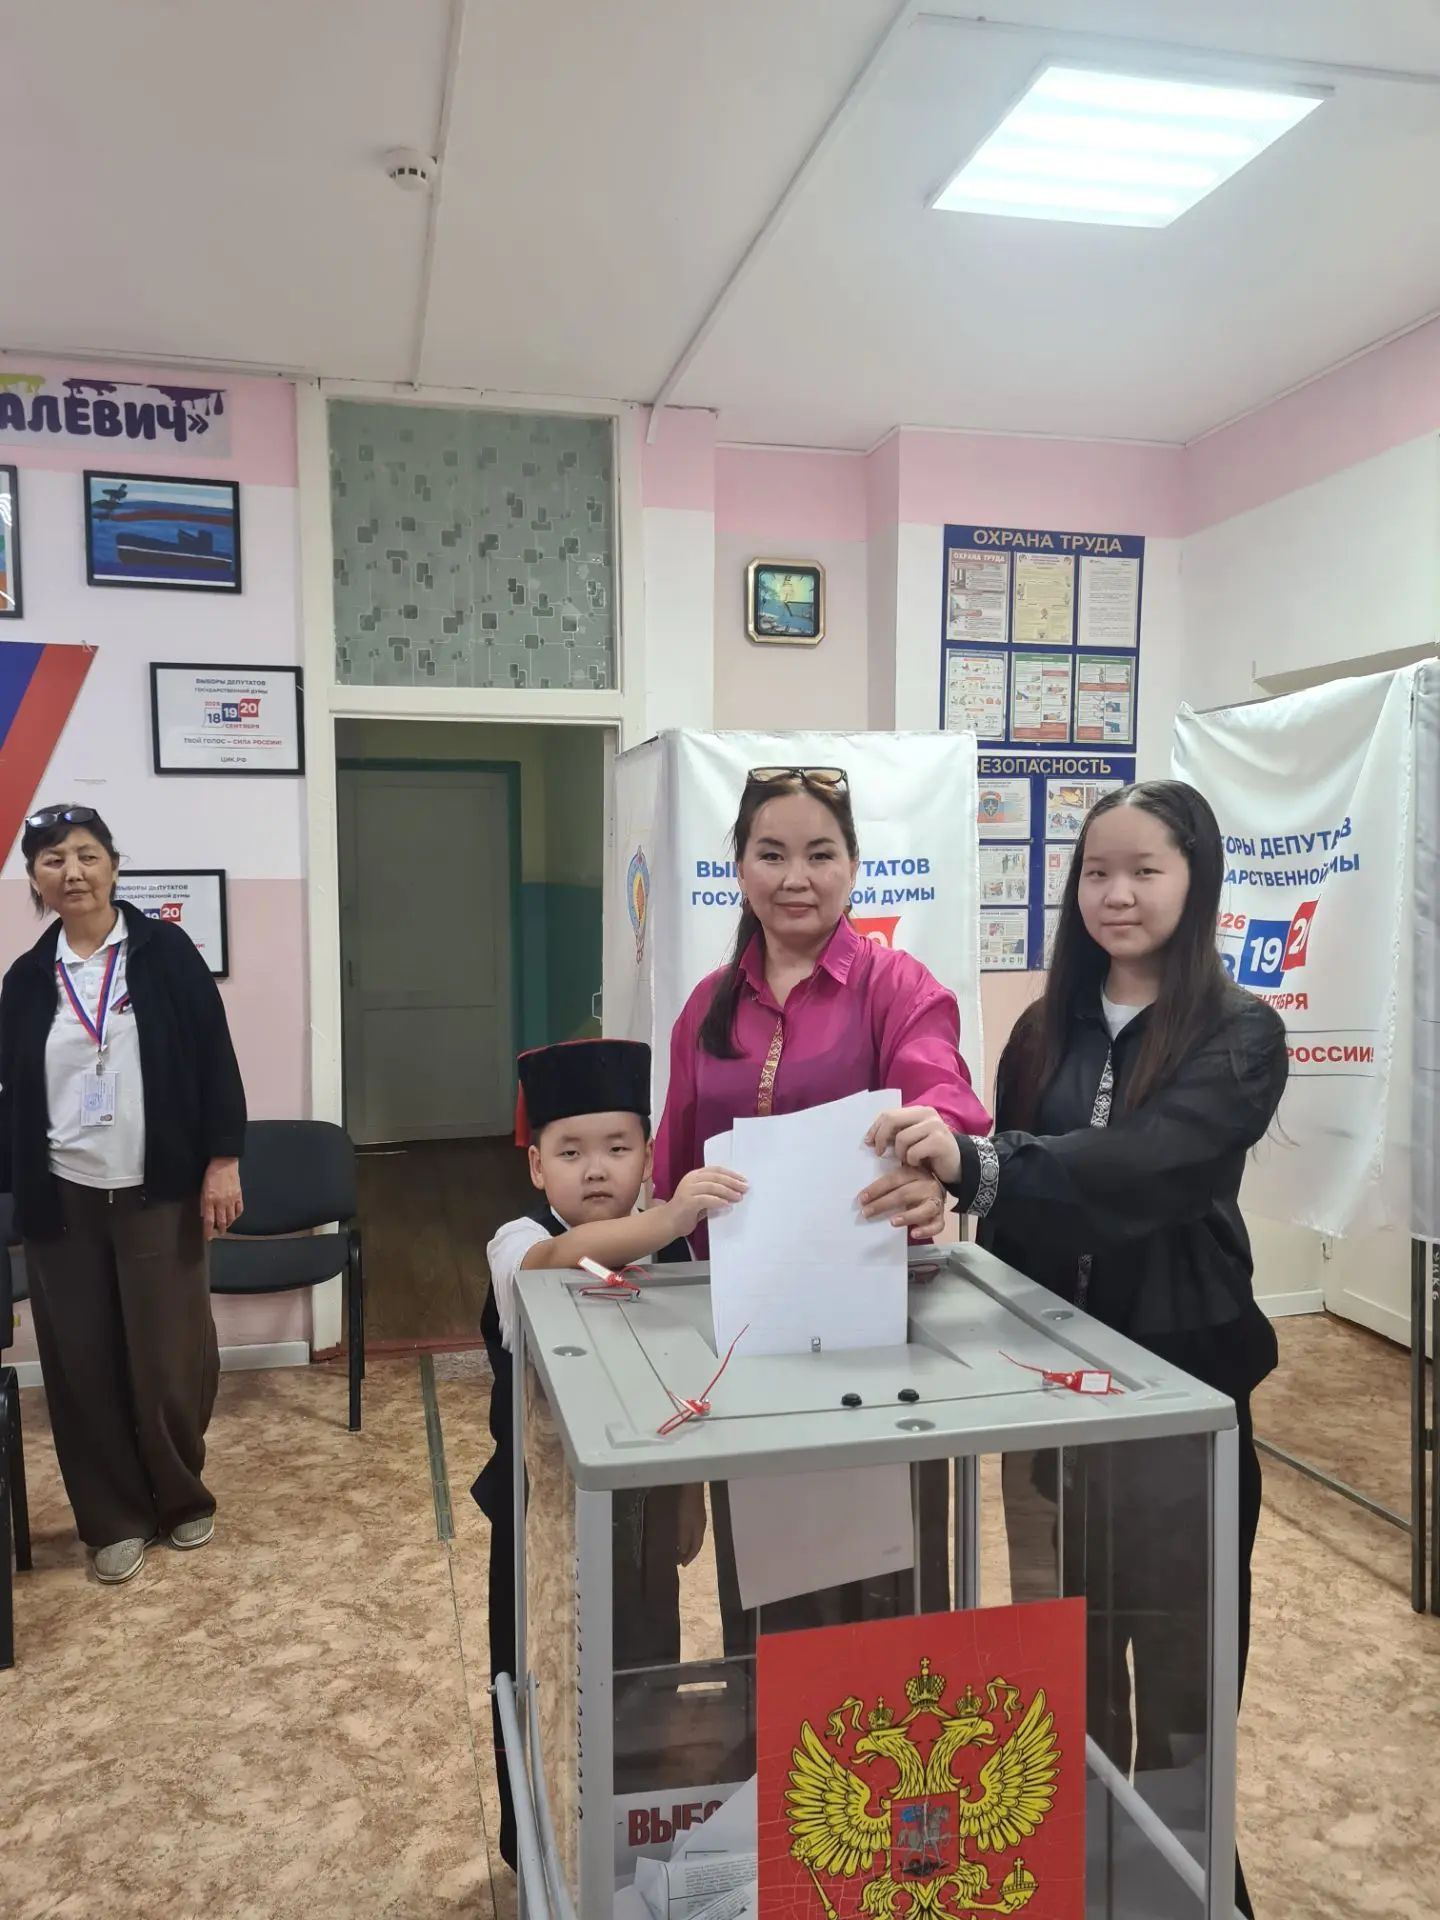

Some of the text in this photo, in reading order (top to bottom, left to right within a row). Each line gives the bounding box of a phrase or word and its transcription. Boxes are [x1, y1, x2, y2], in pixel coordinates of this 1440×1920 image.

[0, 392, 209, 442] АЛЕВИЧ»
[973, 529, 1122, 555] ОХРАНА ТРУДА
[953, 552, 1005, 563] ОХРАНА ТРУДА
[208, 702, 257, 723] 18 19 20
[977, 758, 1111, 775] ЕЗОПАСНОСТЬ
[862, 858, 930, 877] ТАТОВ
[1224, 862, 1329, 887] АРСТВЕННОЙ
[881, 886, 935, 906] ДУМЫ
[162, 907, 180, 918] 20
[1249, 936, 1283, 974] 19
